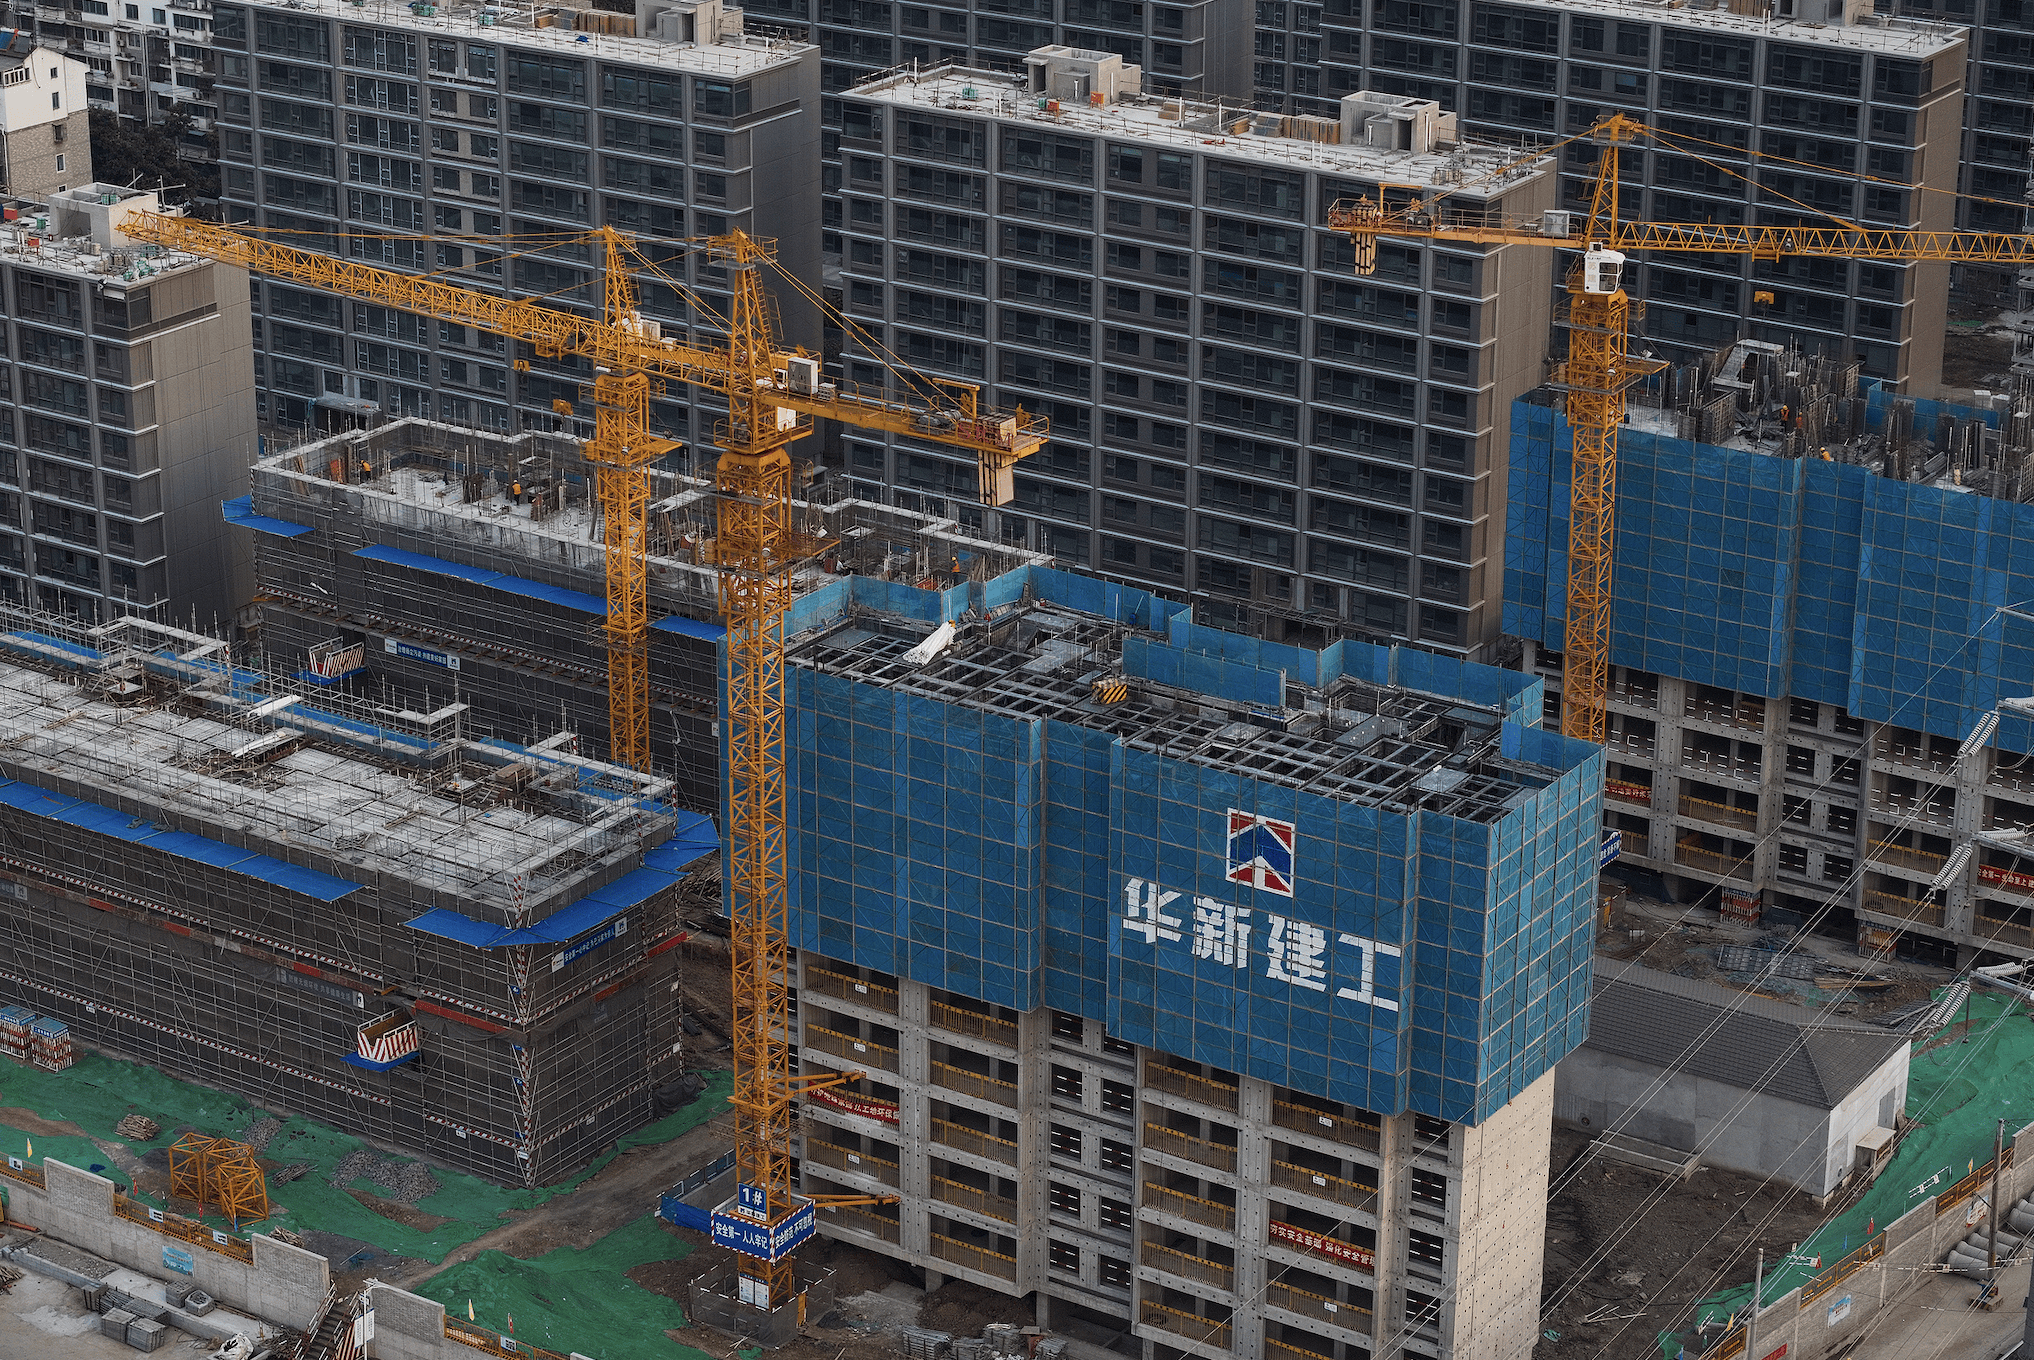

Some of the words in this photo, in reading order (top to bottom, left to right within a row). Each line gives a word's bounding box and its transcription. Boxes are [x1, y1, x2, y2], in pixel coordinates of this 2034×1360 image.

[1122, 878, 1401, 1012] 华新建工
[742, 1187, 763, 1206] 1#
[715, 1222, 741, 1239] 安全第一
[742, 1230, 768, 1249] 人人牢记
[1269, 1223, 1322, 1249] 夯实安全基础
